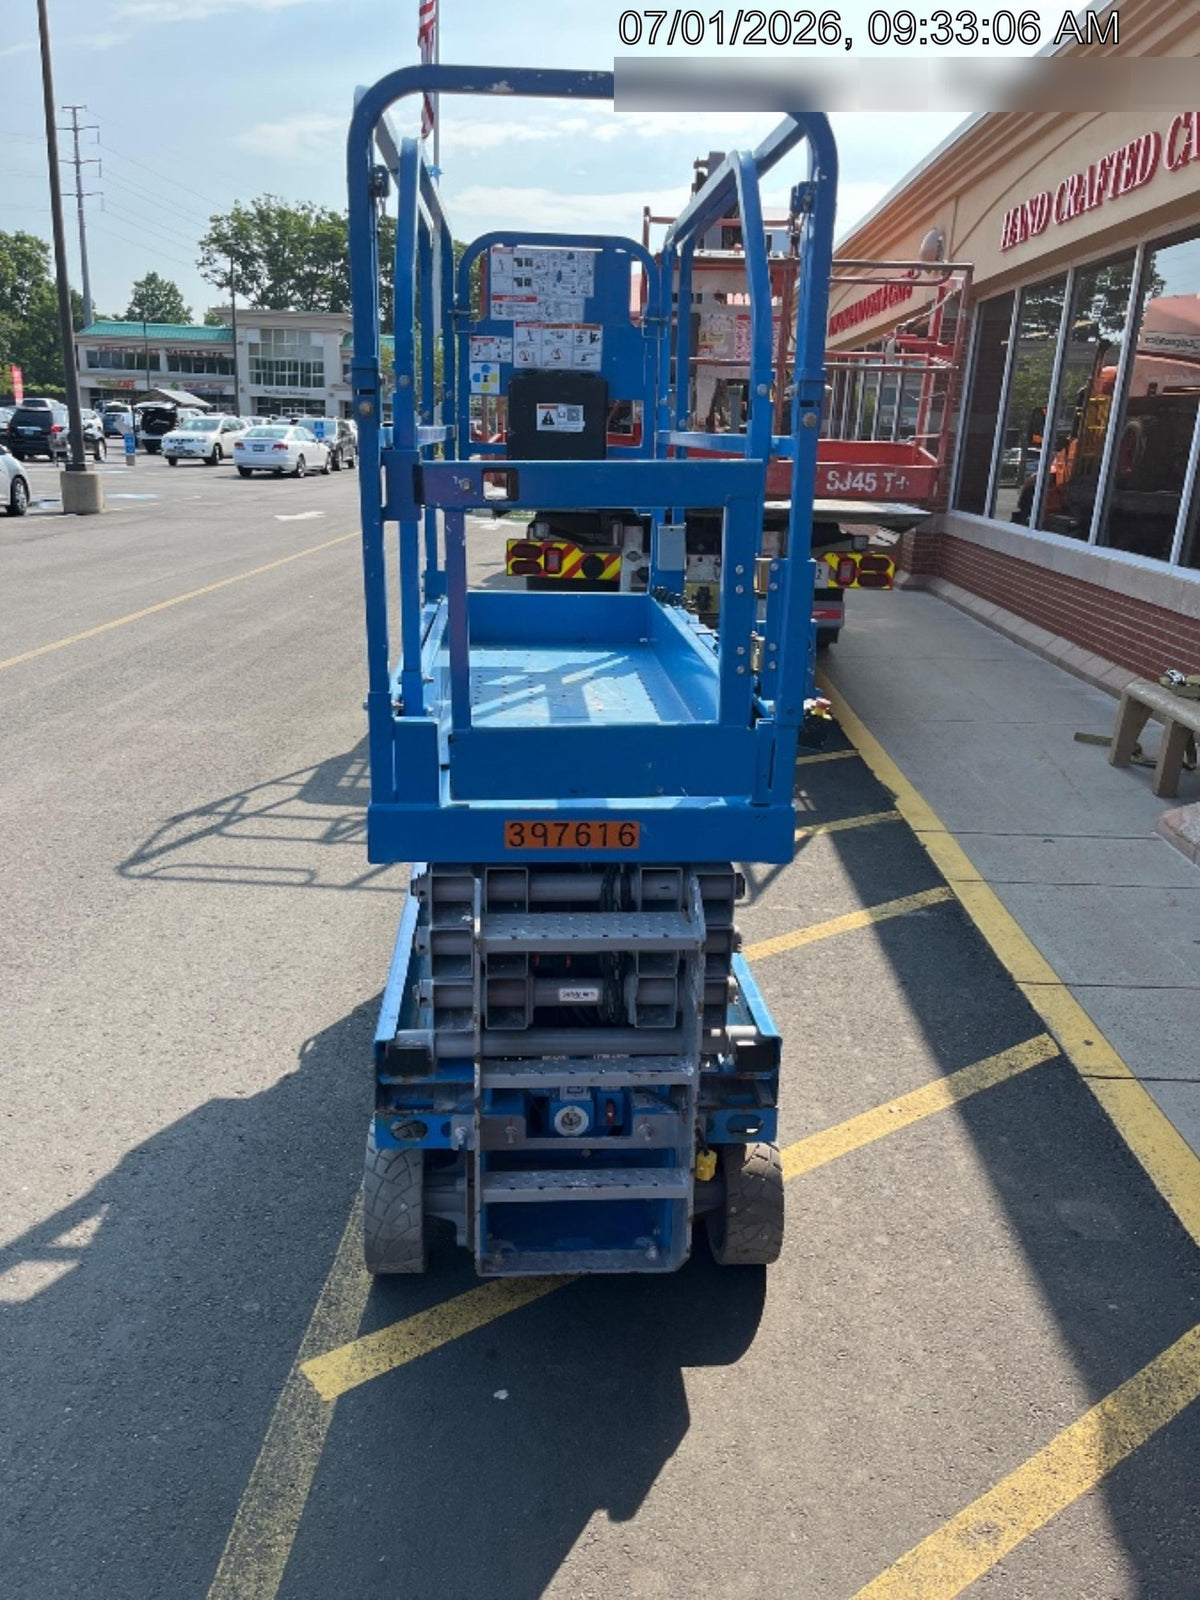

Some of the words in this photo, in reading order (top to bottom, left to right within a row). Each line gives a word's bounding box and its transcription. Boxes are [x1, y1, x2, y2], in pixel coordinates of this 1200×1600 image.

[1001, 191, 1052, 251] HAND
[1053, 131, 1161, 225] CRAFTED
[826, 470, 878, 492] SJ45
[509, 822, 635, 847] 397616
